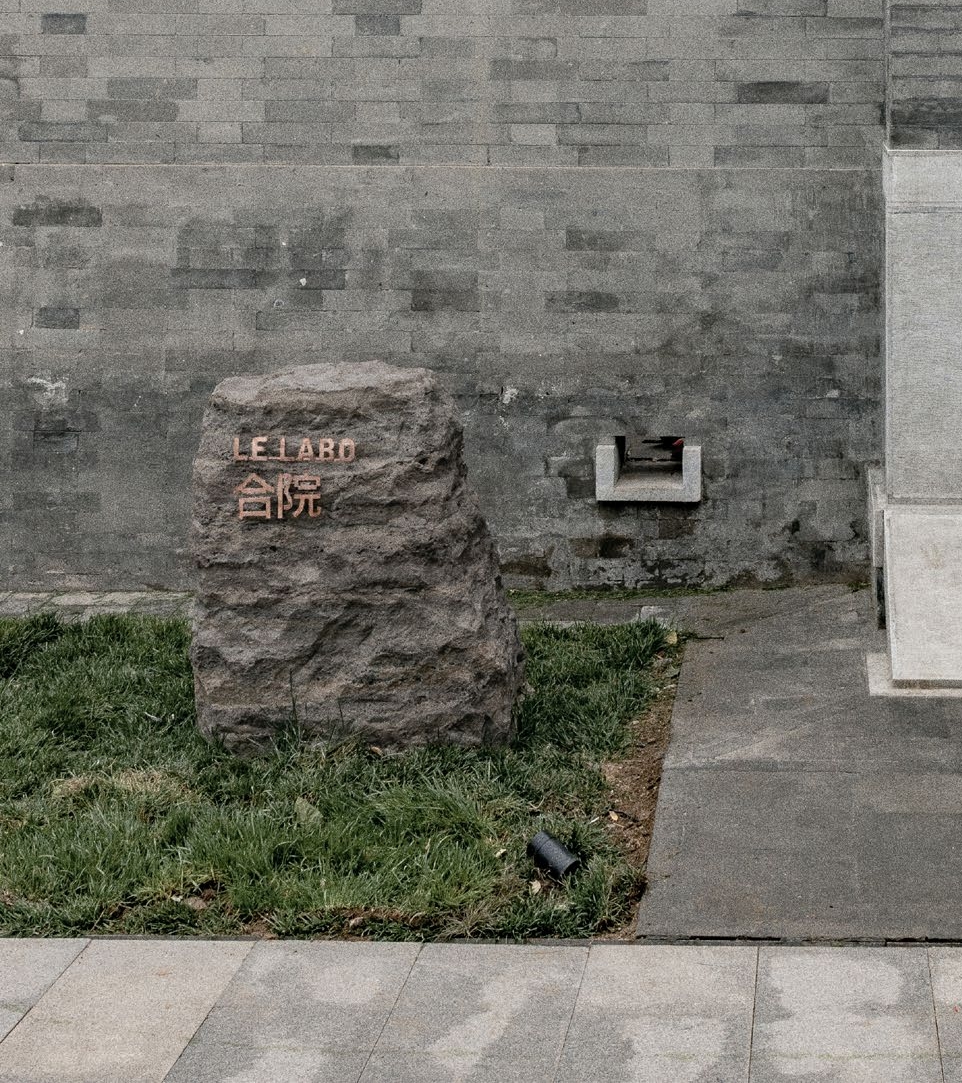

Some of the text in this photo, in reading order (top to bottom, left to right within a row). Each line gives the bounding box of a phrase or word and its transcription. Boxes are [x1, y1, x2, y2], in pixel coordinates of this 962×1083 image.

[232, 436, 356, 463] LE LABO
[233, 472, 322, 519] 合院
